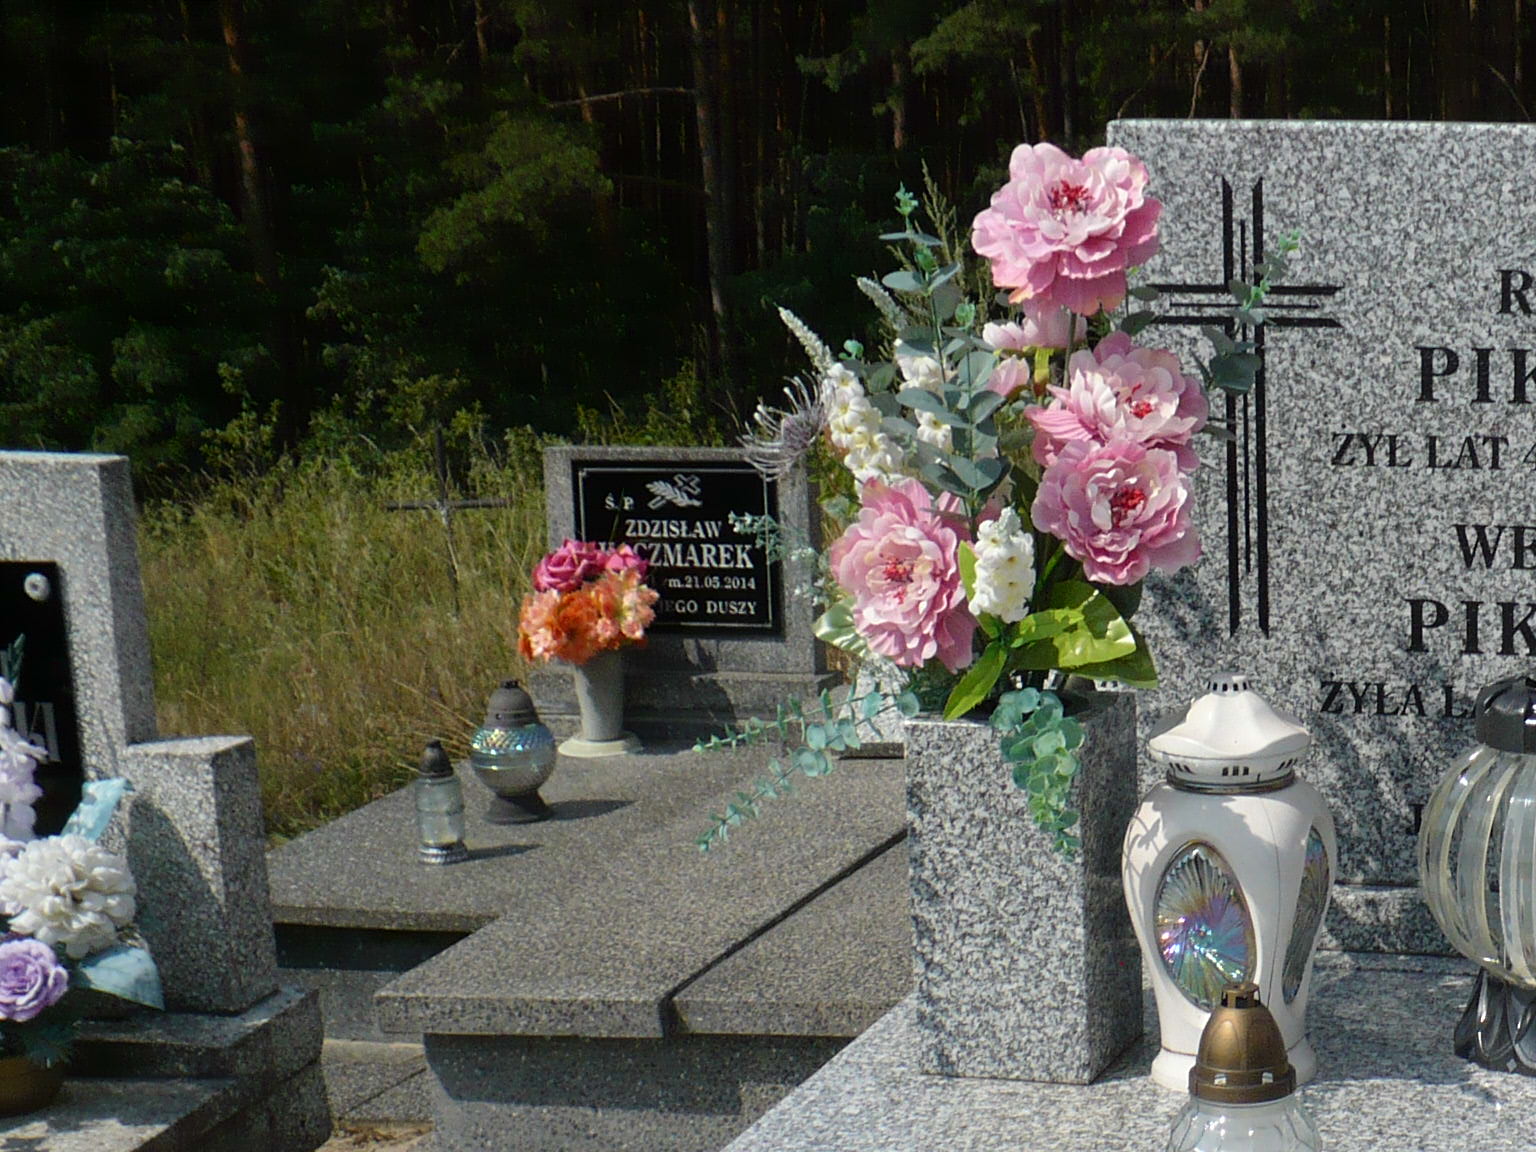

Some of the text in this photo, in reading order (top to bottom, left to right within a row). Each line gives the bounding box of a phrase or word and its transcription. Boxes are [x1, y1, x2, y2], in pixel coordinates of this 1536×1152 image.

[1331, 422, 1412, 467] ŻYŁ
[1427, 435, 1509, 470] LAT
[625, 519, 722, 539] ZDZISŁAW
[599, 542, 754, 569] CZMAREK
[705, 601, 756, 615] DUSZY
[1320, 672, 1427, 718] ŻYŁA
